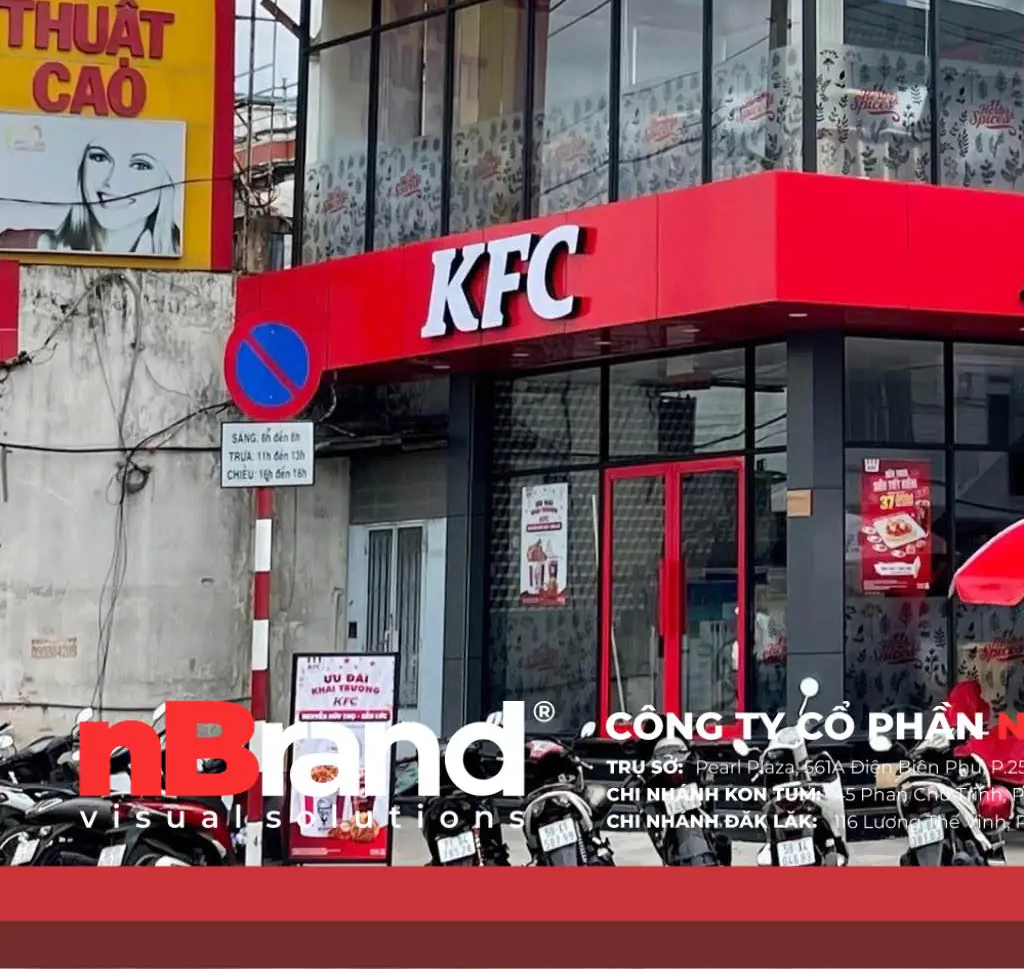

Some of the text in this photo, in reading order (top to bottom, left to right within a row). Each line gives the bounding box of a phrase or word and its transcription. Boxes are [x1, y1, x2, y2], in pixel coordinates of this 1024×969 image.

[32, 61, 147, 117] CAO
[420, 224, 580, 339] KFC
[333, 696, 357, 706] KFC
